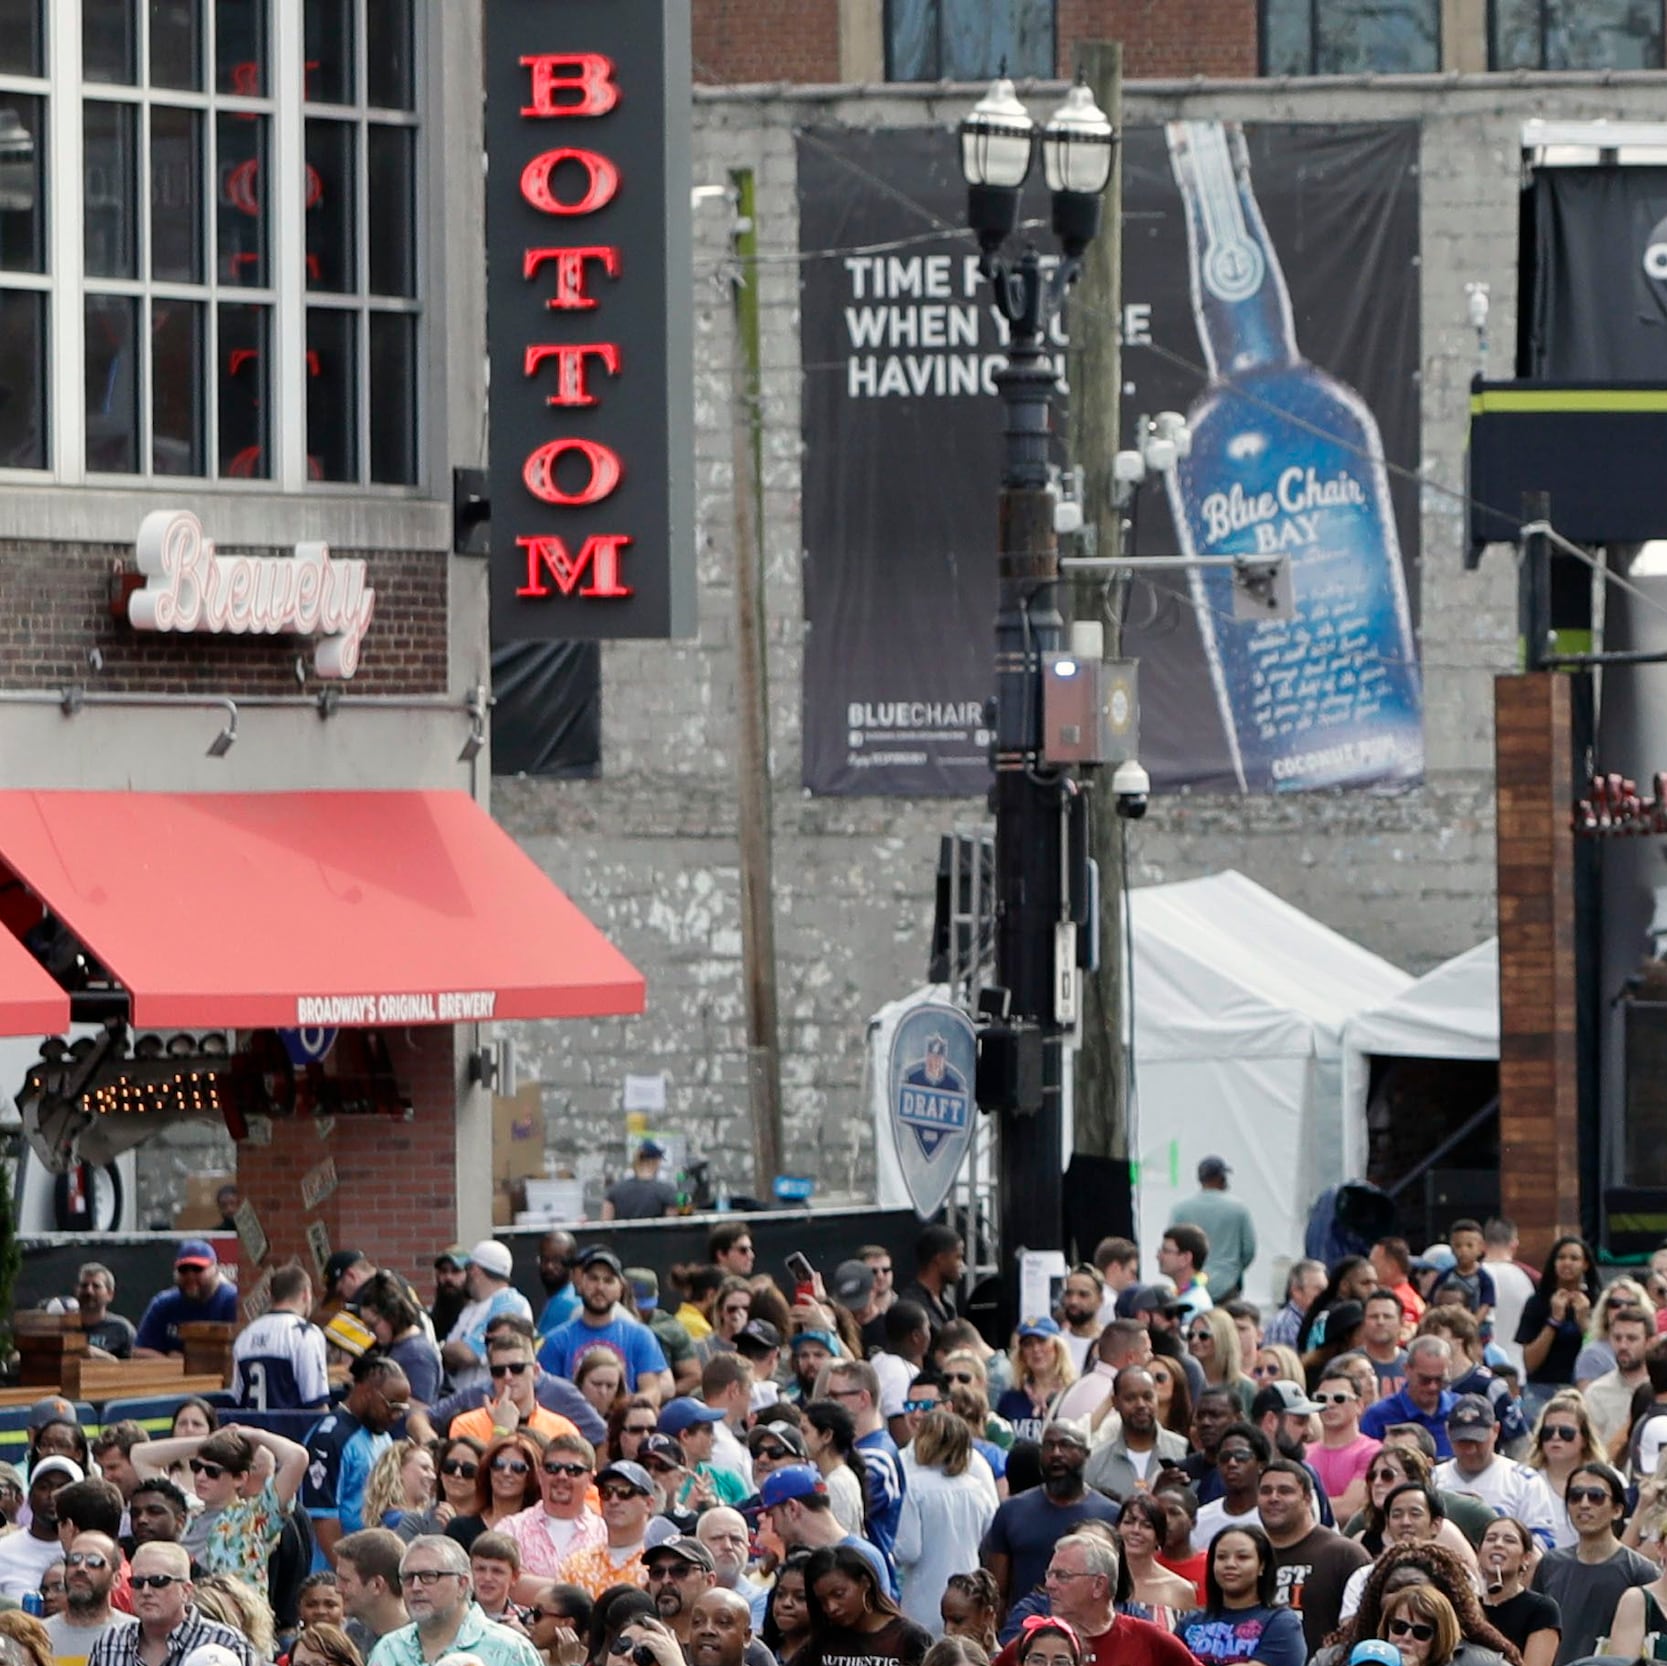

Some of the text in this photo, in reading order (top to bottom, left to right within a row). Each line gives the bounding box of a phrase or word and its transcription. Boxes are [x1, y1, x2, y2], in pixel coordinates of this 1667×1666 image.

[845, 255, 951, 298] TIME
[514, 52, 634, 600] BOTTOM
[845, 305, 980, 347] WHEN
[1203, 466, 1366, 545] Blue Chair
[1254, 513, 1321, 552] BAY
[130, 509, 375, 681] Brewery
[1271, 741, 1355, 780] COCONUT
[298, 991, 496, 1024] BROADWAY'S ORIGINAL BREWERY
[904, 1087, 961, 1117] DRAFT
